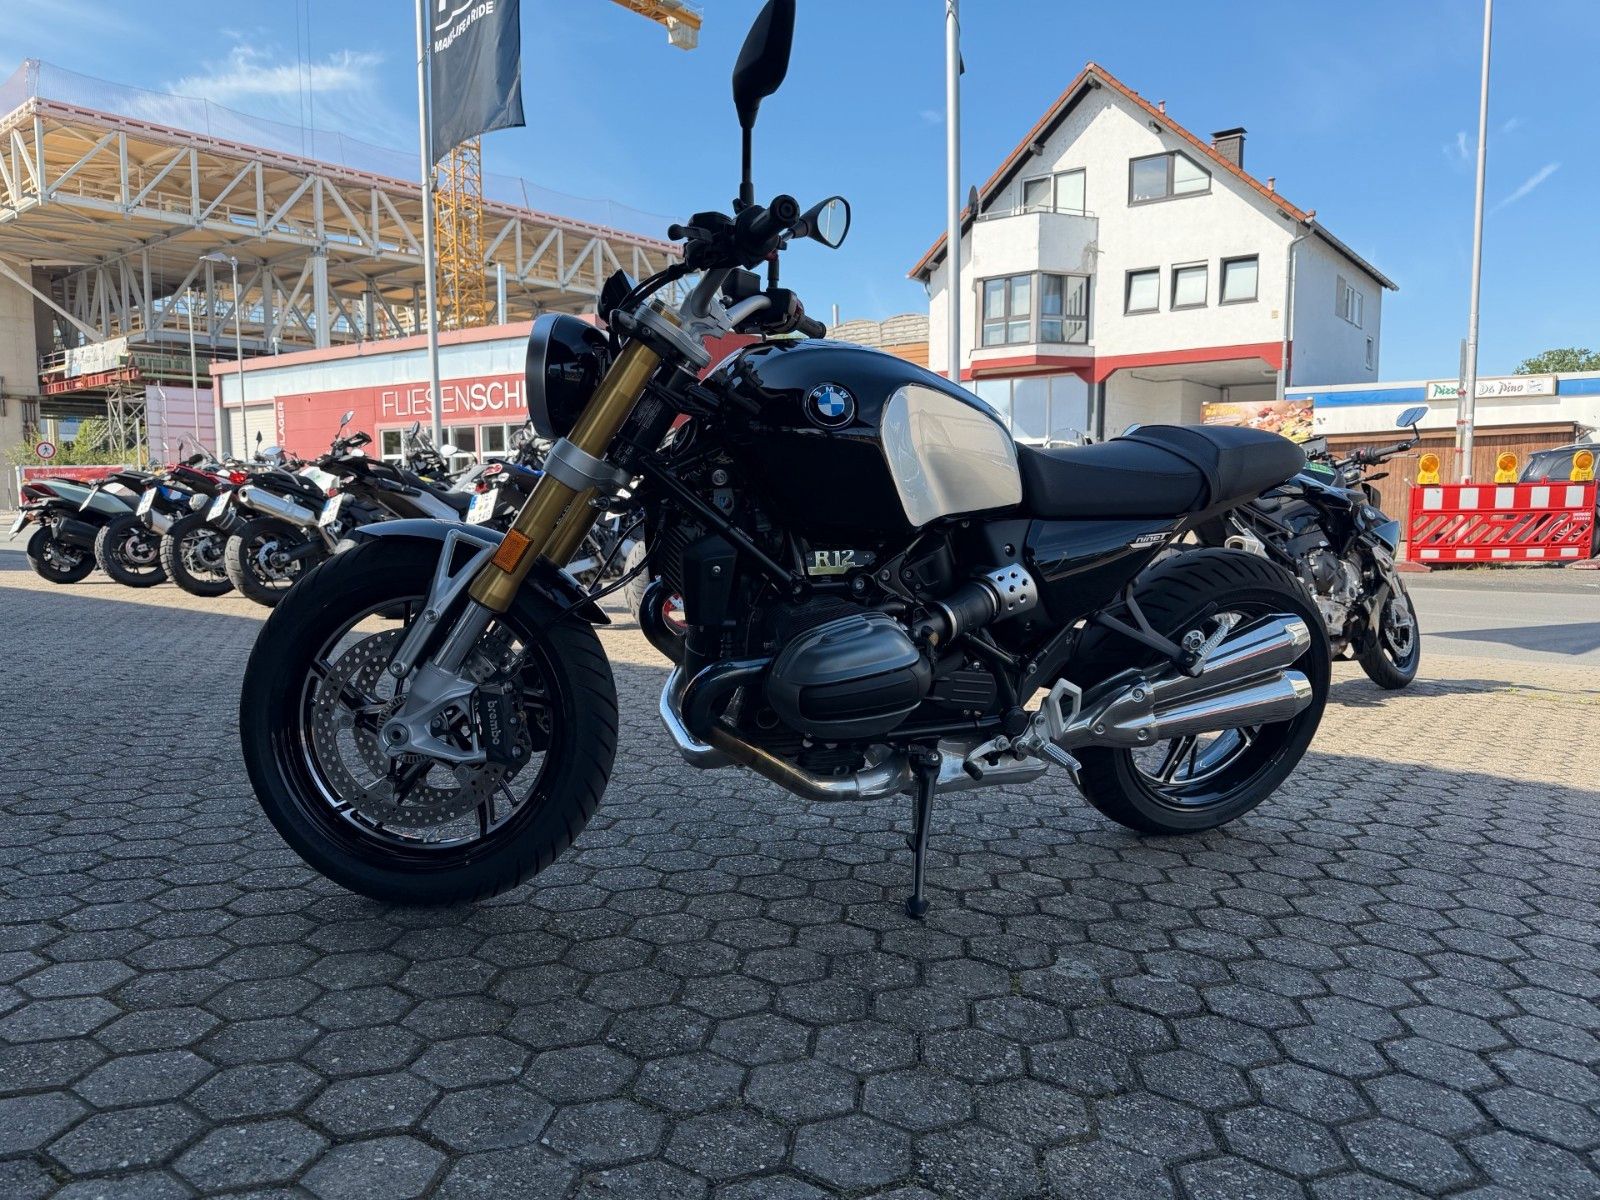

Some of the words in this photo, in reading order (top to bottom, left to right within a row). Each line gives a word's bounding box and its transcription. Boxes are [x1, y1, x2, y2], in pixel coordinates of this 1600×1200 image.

[471, 1, 493, 23] RIDE
[813, 386, 849, 399] BMW
[1433, 383, 1458, 398] Pizz
[1498, 381, 1524, 395] Pino
[487, 700, 501, 745] brembo
